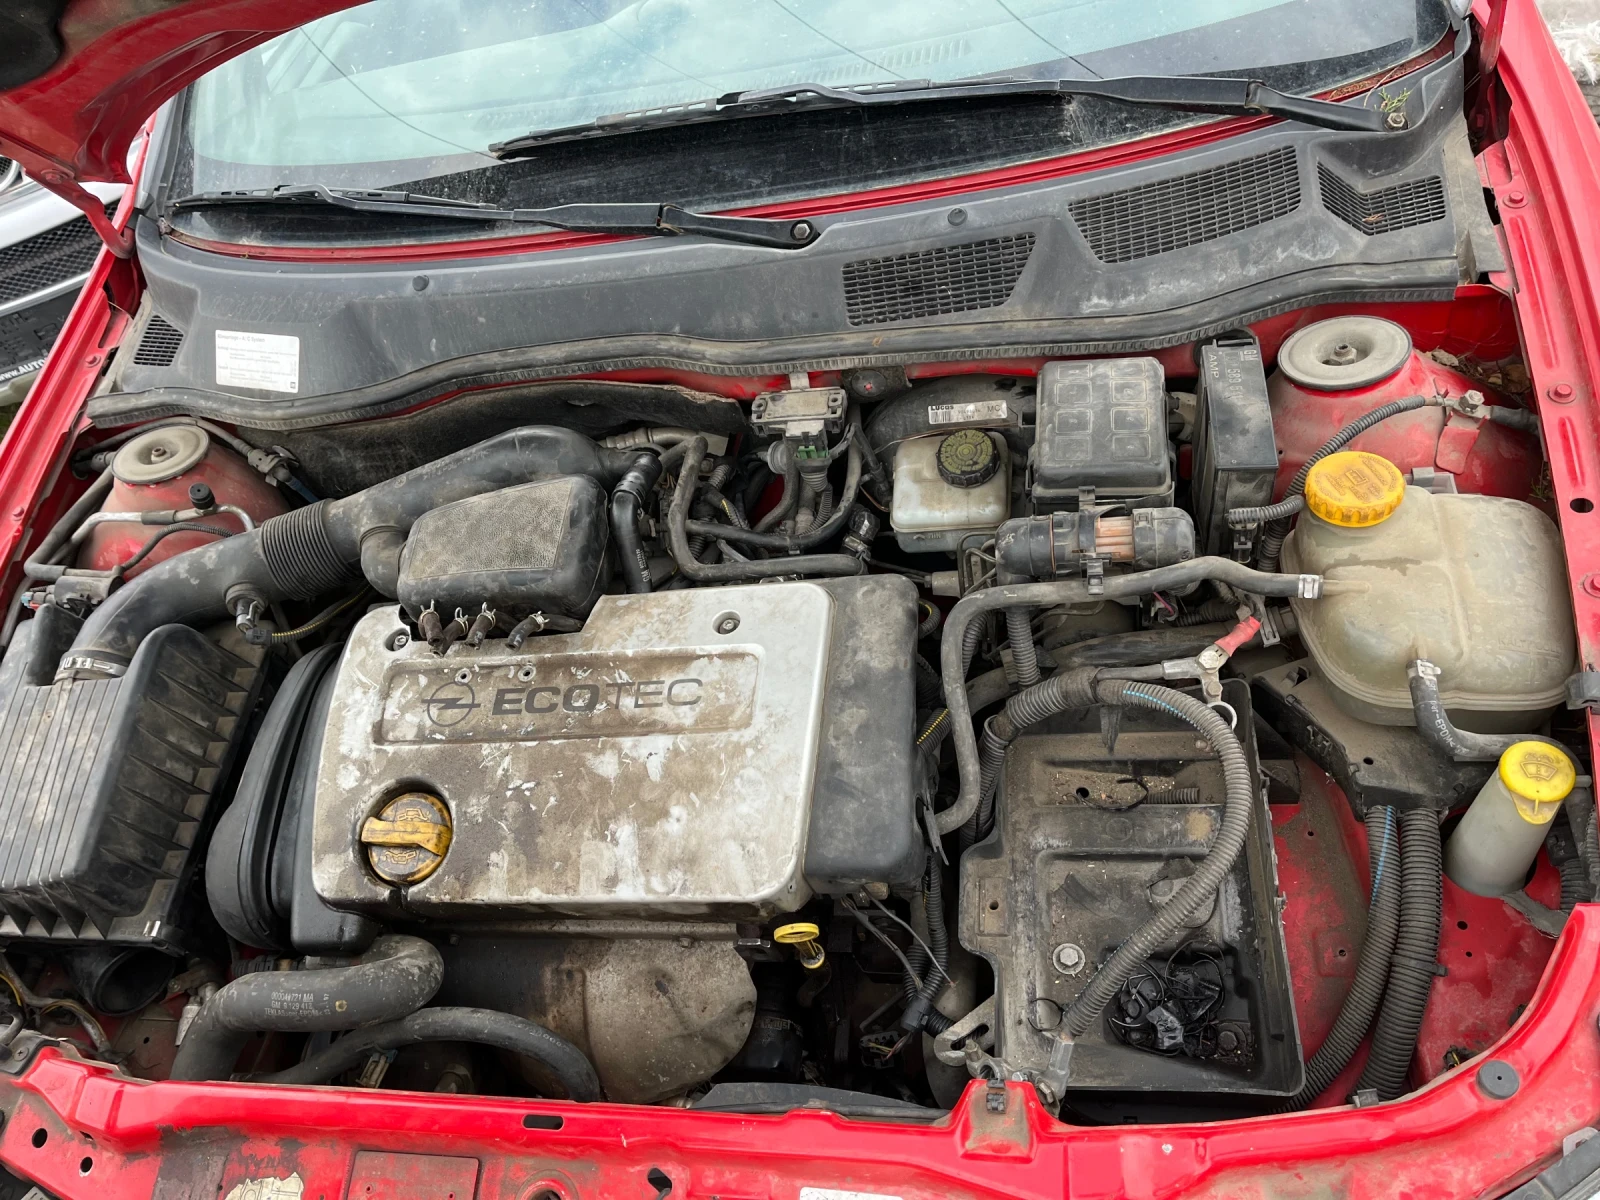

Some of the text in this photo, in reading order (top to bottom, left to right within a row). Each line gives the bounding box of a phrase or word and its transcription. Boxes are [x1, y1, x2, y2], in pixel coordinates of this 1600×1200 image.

[1208, 353, 1220, 378] AMP
[491, 678, 703, 716] ECOTEC
[271, 1000, 281, 1009] GM
